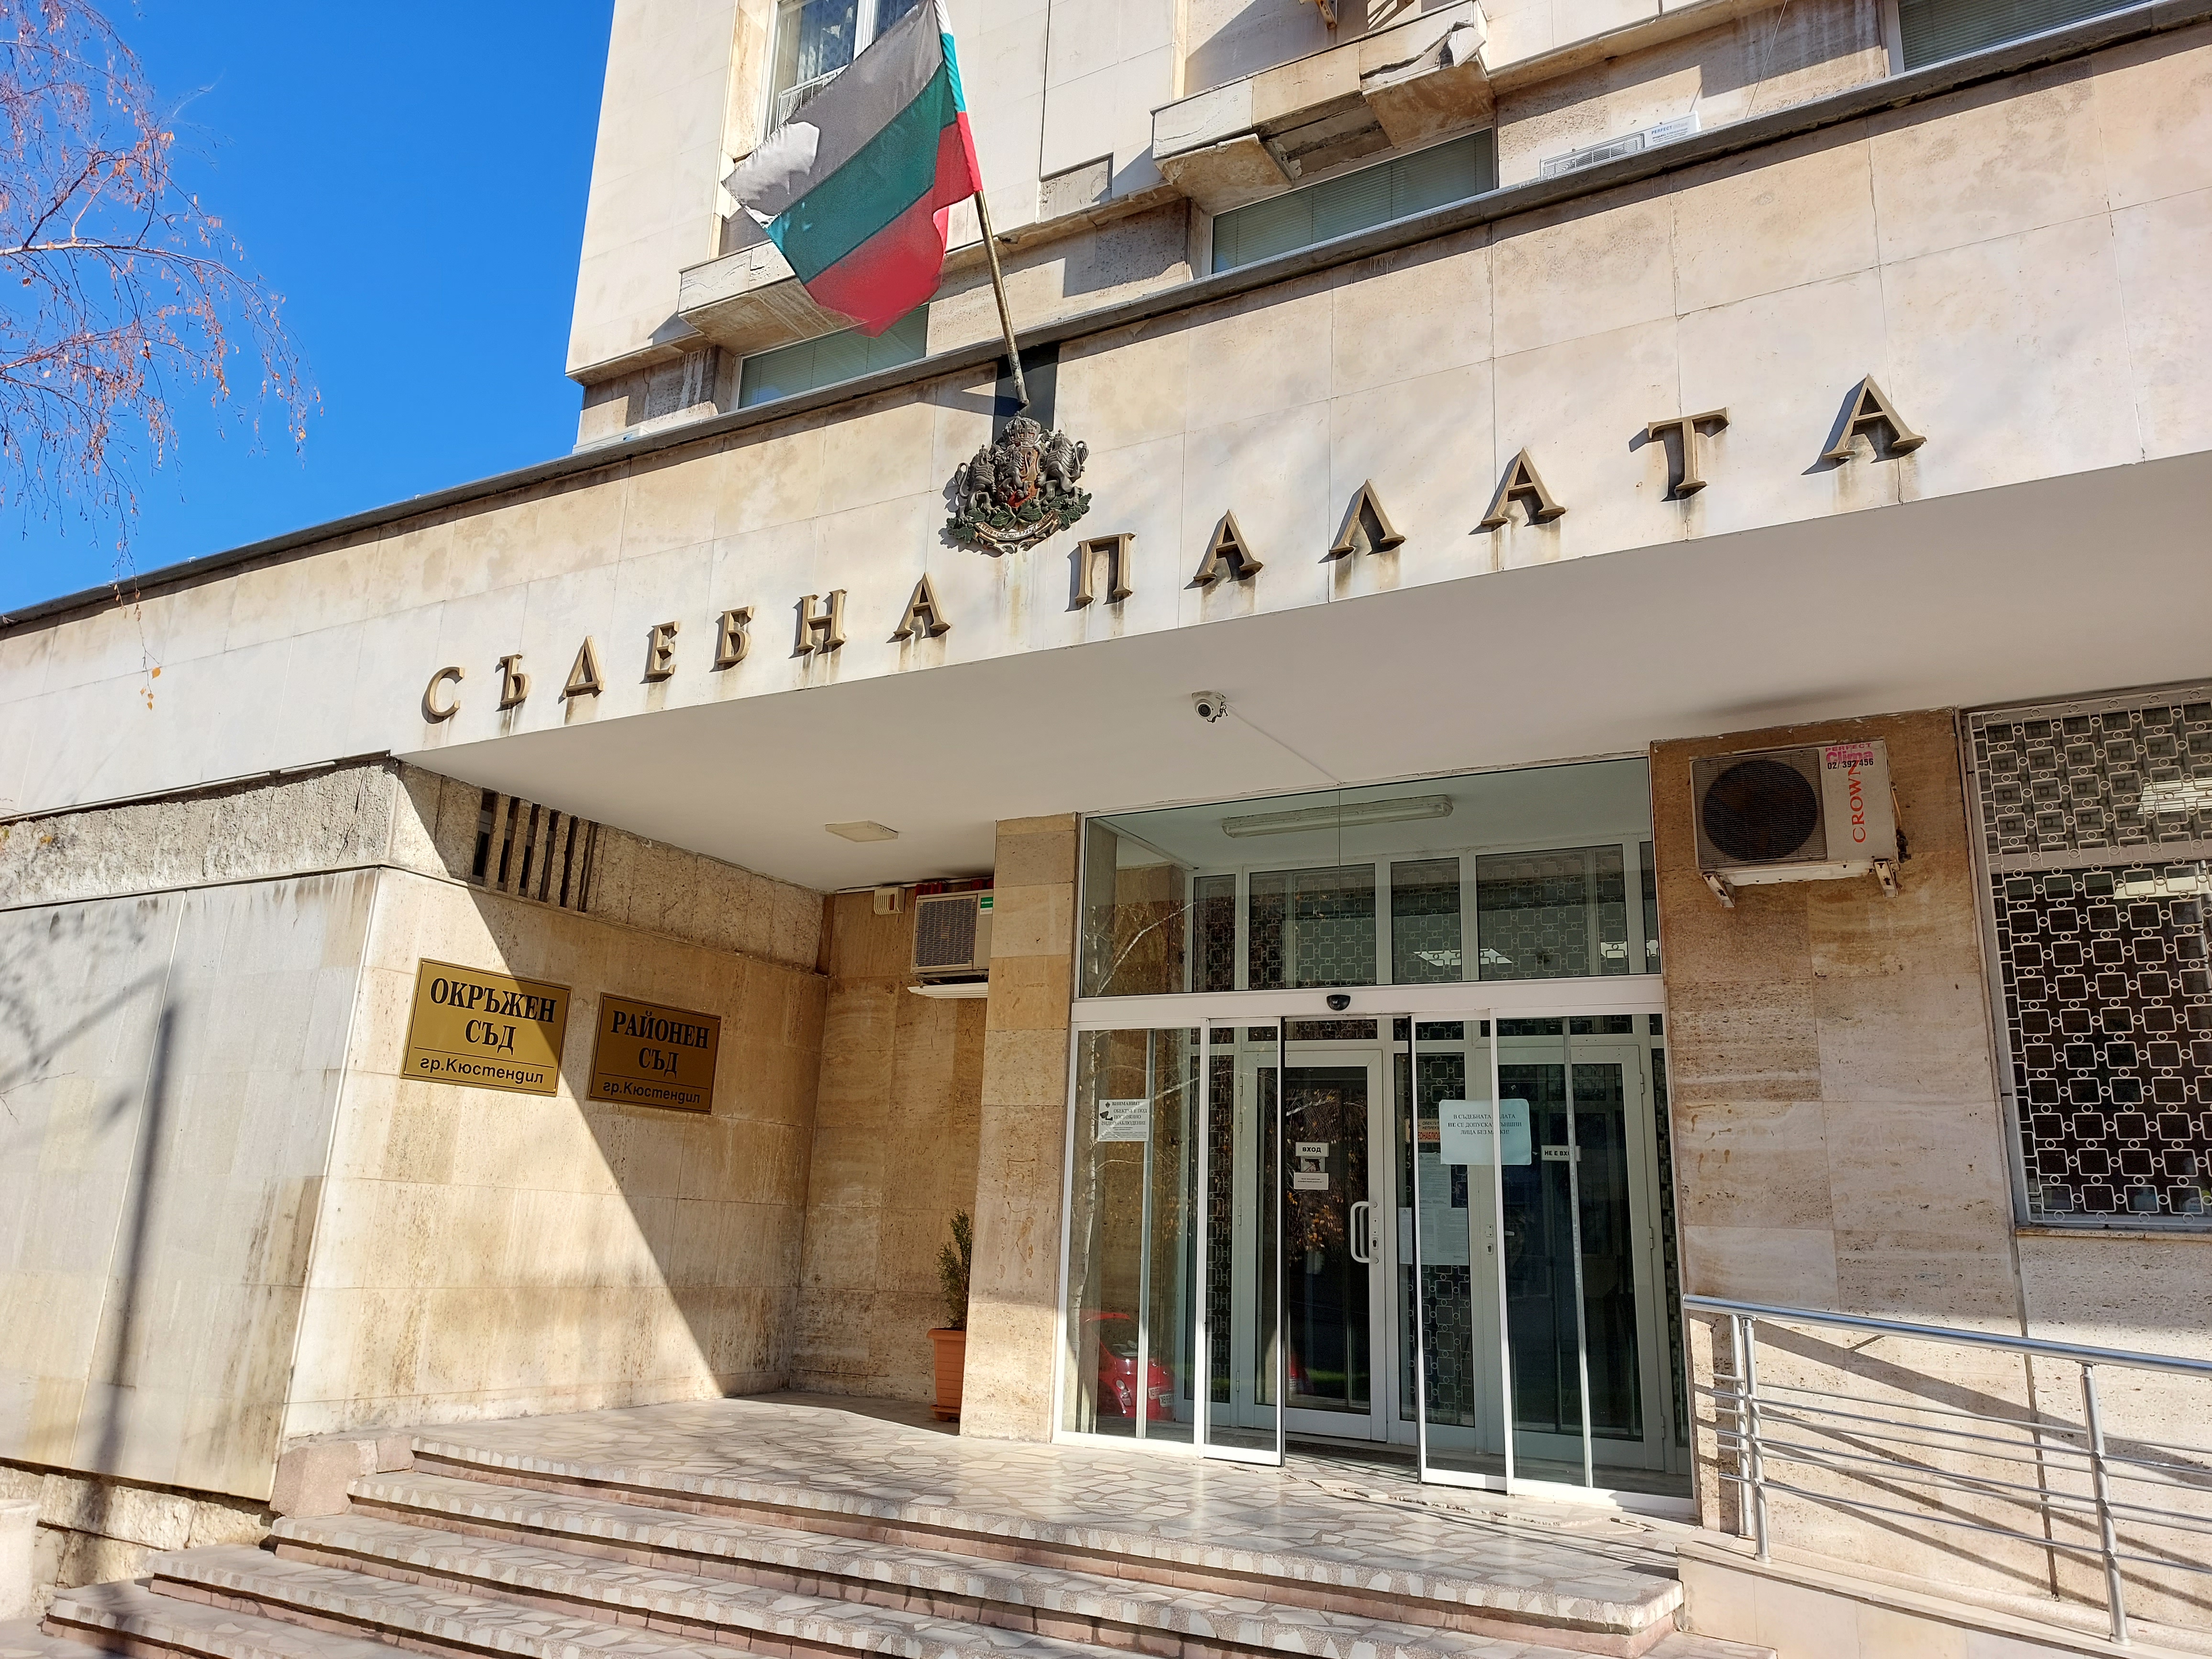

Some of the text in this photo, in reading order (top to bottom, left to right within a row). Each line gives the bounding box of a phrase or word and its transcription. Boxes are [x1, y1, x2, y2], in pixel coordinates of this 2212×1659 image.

[1651, 125, 1672, 134] PERFECT
[426, 374, 1926, 717] СЪДЕБНА ПАЛАТА
[1825, 742, 1872, 752] PERFECT
[1826, 751, 1874, 764] Clima
[1827, 758, 1874, 770] 02/ 392 456
[1848, 760, 1866, 843] CROWN
[430, 978, 556, 1023] ОКРЪЖЕН
[465, 1019, 517, 1055] СЪД
[610, 1010, 710, 1049] РАЙОНЕН
[420, 1058, 543, 1084] гр.Кюстендил
[639, 1047, 679, 1079] СЪД
[603, 1082, 700, 1104] гр.Кюстендил
